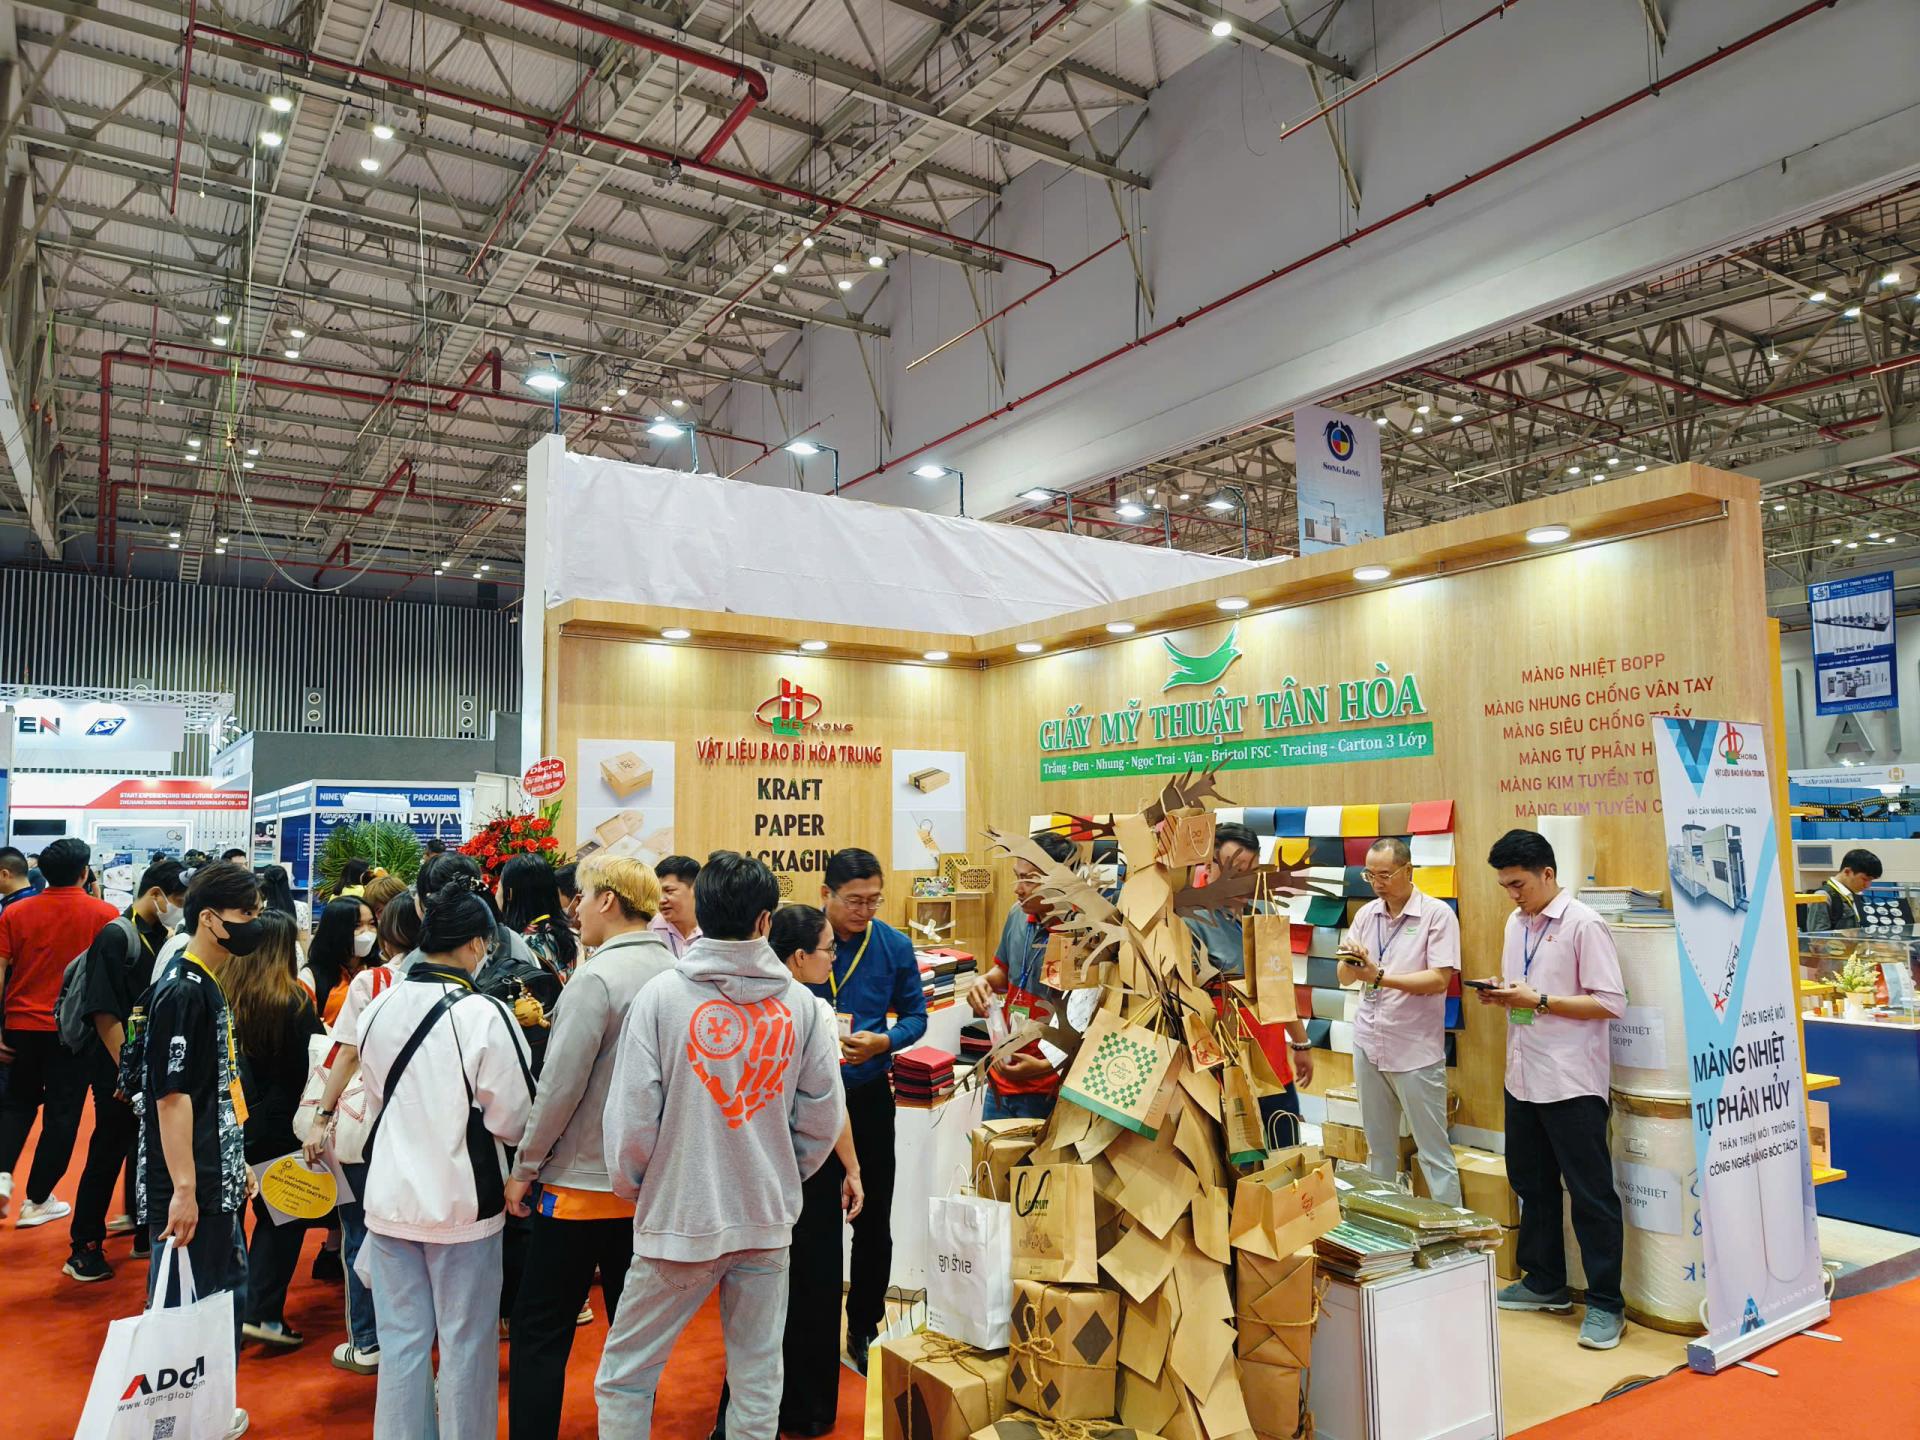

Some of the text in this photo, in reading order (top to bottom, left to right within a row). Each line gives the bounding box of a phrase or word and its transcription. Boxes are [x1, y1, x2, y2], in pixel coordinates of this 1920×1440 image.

[1522, 653, 1665, 685] MÀNG NHIỆT BOPP
[1039, 661, 1428, 752] GIẤY MỸ THUẬT TÂN HÒA
[1484, 676, 1714, 717] MÀNG NHUNG CHỐNG VÂN TAY
[1503, 721, 1545, 740] MÀNG
[1550, 717, 1584, 735] SIÊU
[1589, 709, 1645, 732] CHỐNG
[697, 736, 882, 763] VẬT LIỆU BAO BÌ HÒA TRUNG
[1043, 731, 1427, 776] Trắng Đen Nhung Ngọc Trai Vân Bristol FSC Tracing Carton 3 Lớp
[1519, 747, 1561, 765] MÀNG
[1566, 745, 1588, 765] TỰ
[1591, 741, 1636, 760] PHÂN
[757, 778, 823, 800] KRAFT
[1500, 775, 1542, 793] MÀNG
[1547, 772, 1574, 790] KIM
[1580, 767, 1629, 788] TUYẾN
[413, 793, 457, 802] PACKAGING
[1515, 799, 1558, 817] MÀNG
[1563, 798, 1591, 816] KIM
[1595, 793, 1647, 816] TUYẾN
[754, 814, 825, 836] PAPER
[1741, 1011, 1757, 1028] CÔNG
[1758, 1008, 1774, 1026] NGHỆ
[1693, 1031, 1786, 1083] MÀNG NHIỆT
[1696, 1073, 1790, 1138] TỰ PHÂN HỦY
[1719, 1135, 1737, 1152] THÂN
[1709, 1159, 1730, 1177] CÔNG
[1783, 1139, 1798, 1158] TÁCH
[1625, 1195, 1648, 1209] BOPP
